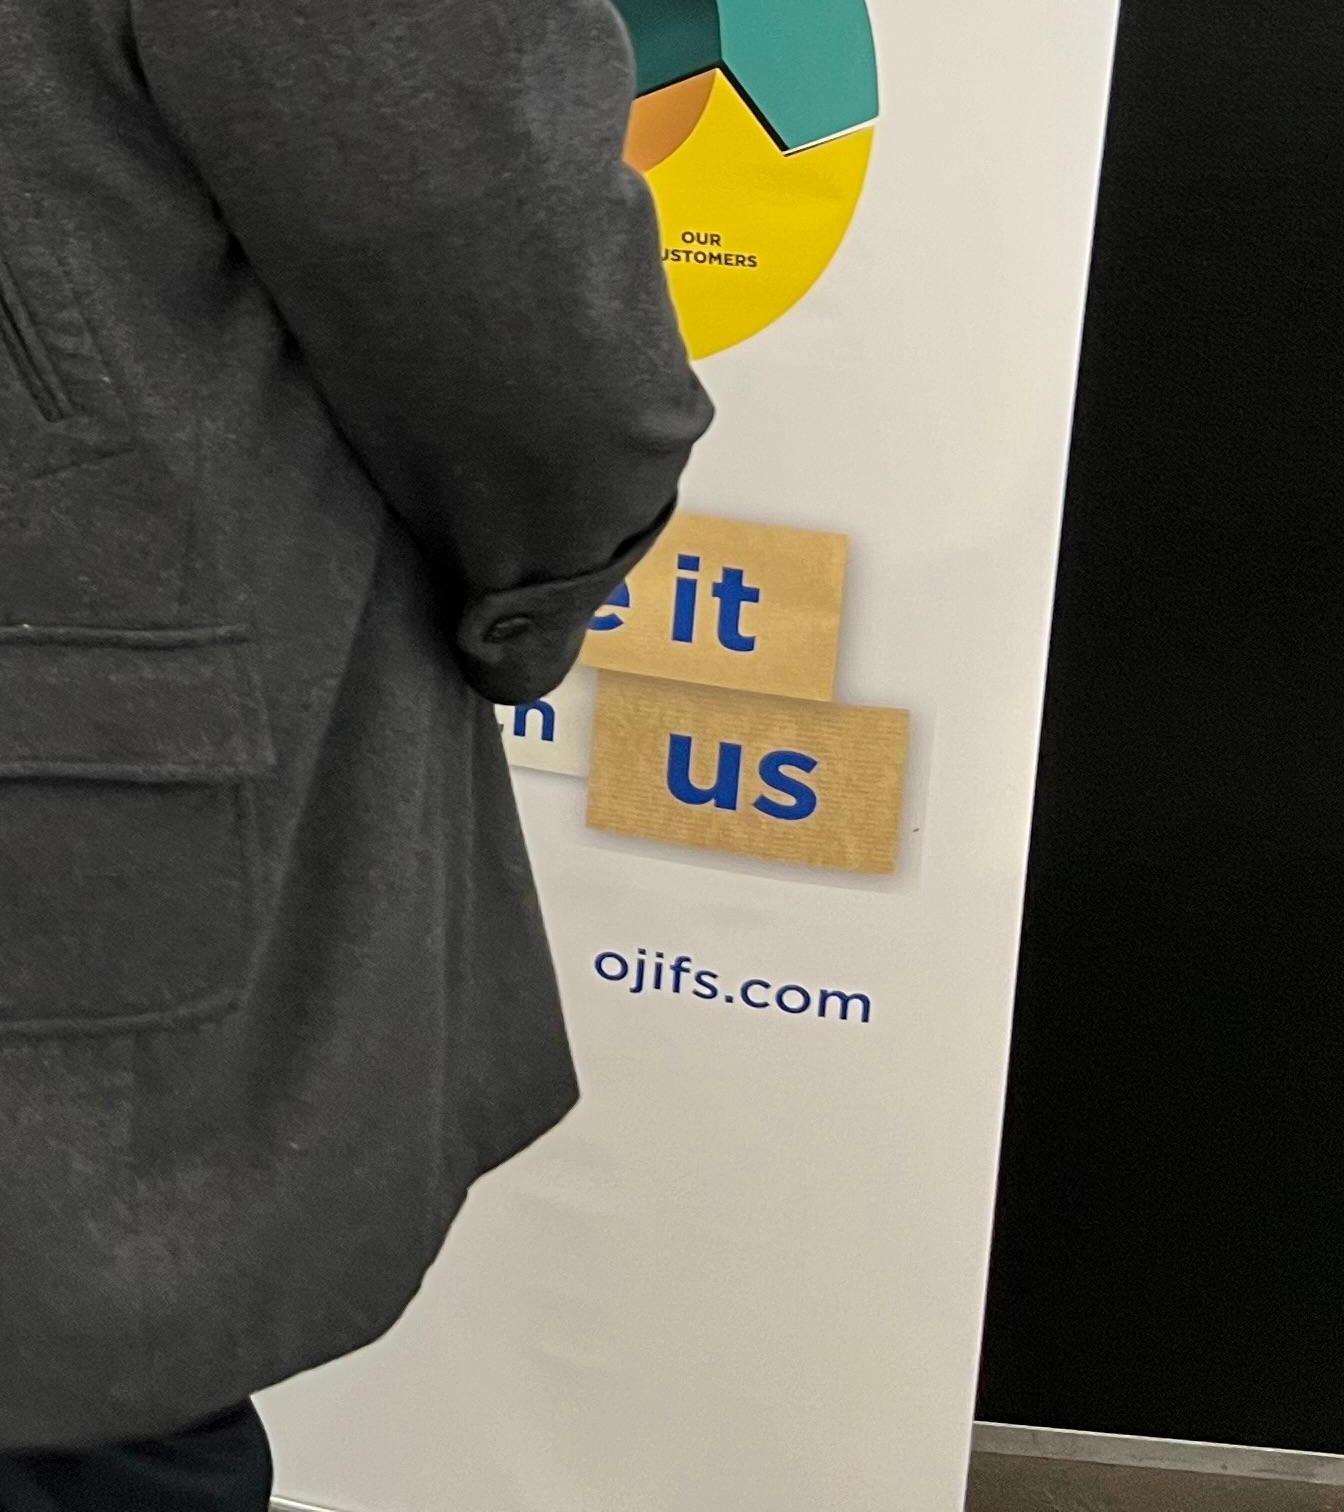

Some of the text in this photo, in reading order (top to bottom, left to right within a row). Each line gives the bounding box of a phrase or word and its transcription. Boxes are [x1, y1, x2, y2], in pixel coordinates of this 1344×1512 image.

[681, 231, 722, 247] OUR
[671, 553, 761, 653] it
[666, 733, 818, 822] us
[594, 948, 872, 1023] ojifs.com
